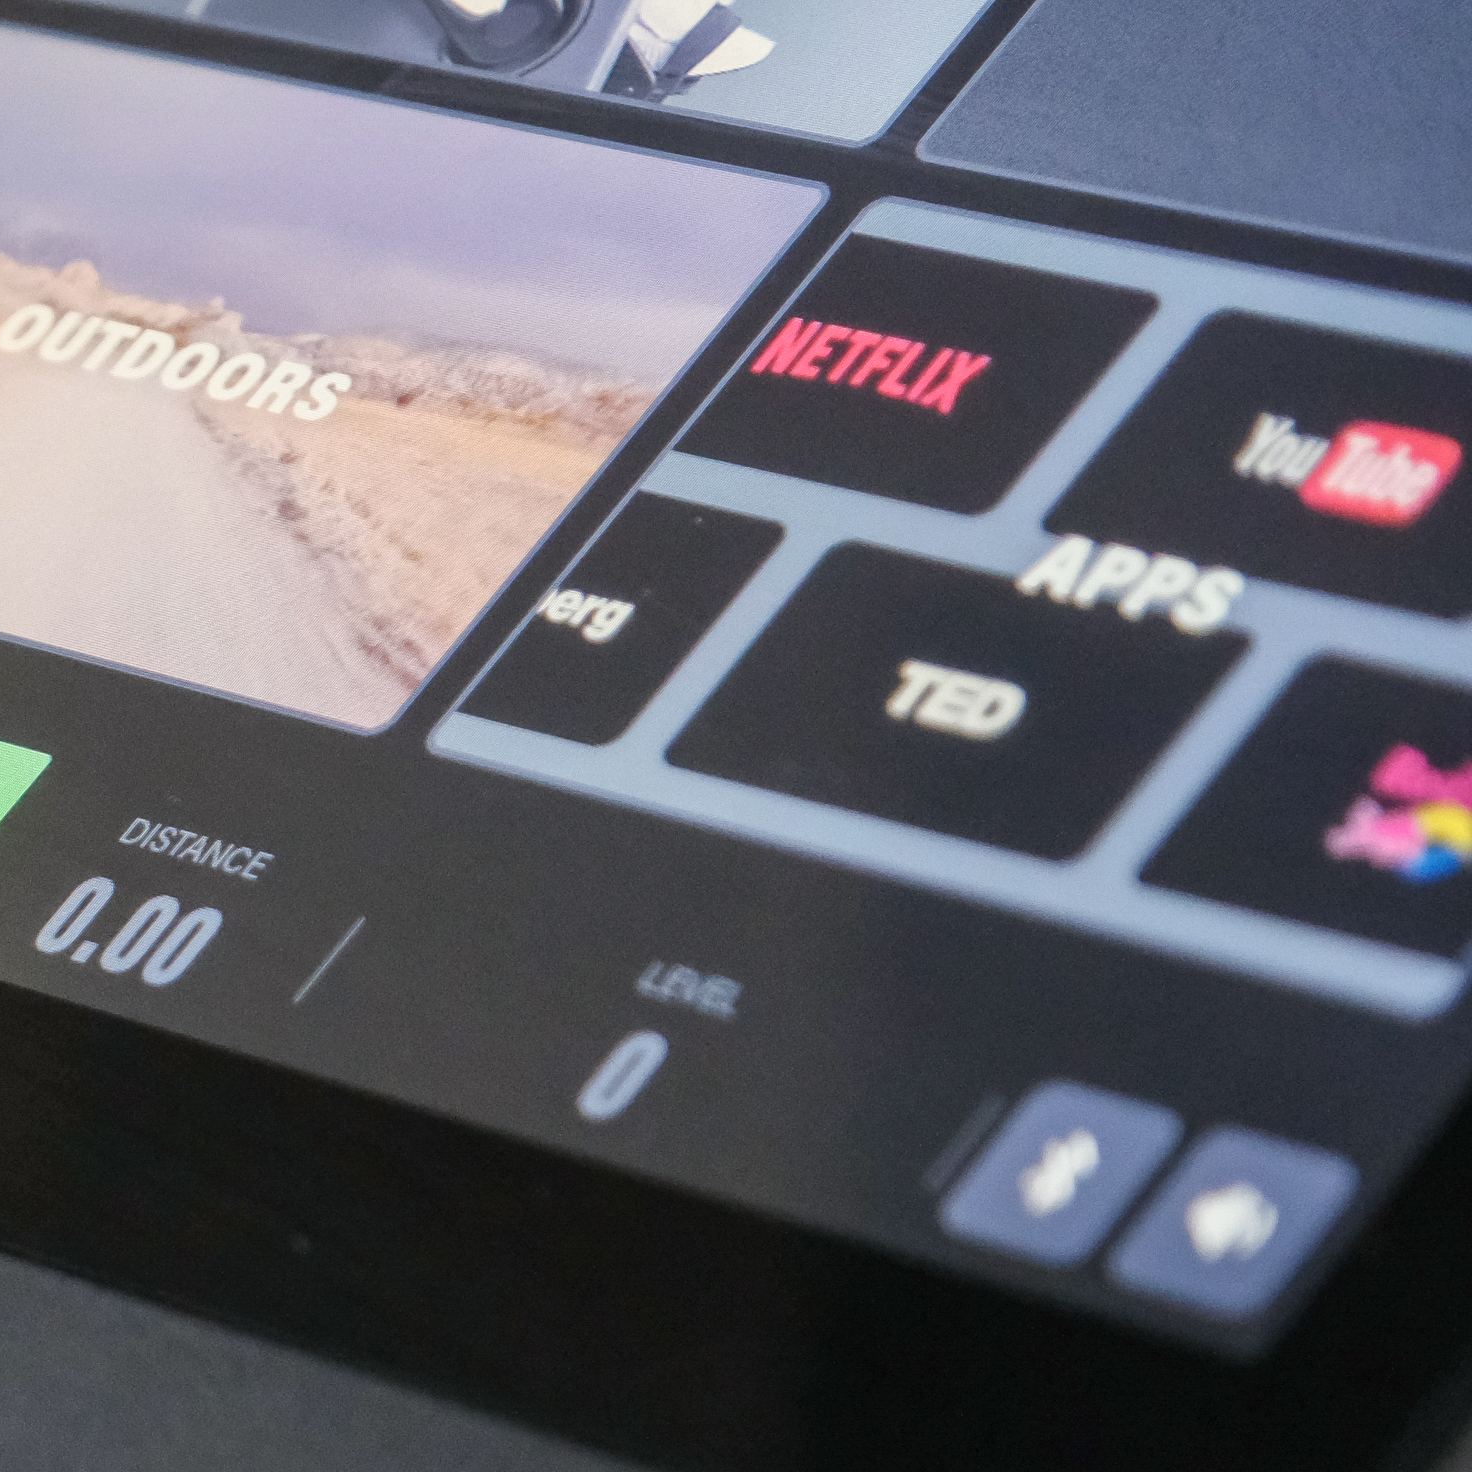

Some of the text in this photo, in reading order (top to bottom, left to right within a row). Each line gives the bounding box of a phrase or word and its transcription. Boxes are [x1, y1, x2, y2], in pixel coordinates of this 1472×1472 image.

[750, 317, 992, 415] NETFLIX
[1233, 411, 1442, 508] YouTube
[536, 588, 636, 644] erg
[1016, 532, 1246, 636] APPS
[885, 657, 1028, 740] TED
[118, 816, 276, 882] DISTANCE
[34, 875, 224, 988] 0.00
[576, 1030, 670, 1124] 0
